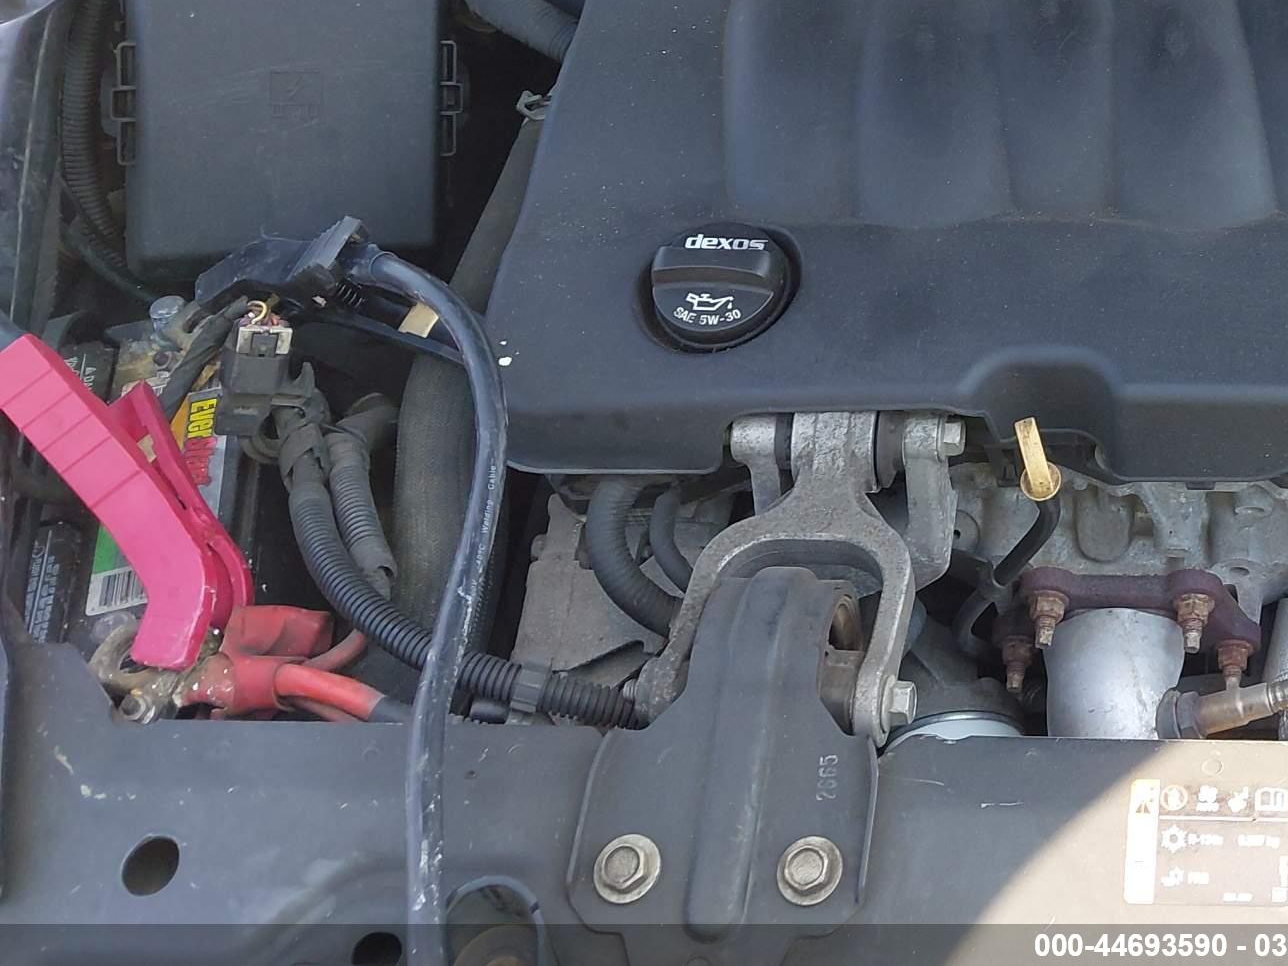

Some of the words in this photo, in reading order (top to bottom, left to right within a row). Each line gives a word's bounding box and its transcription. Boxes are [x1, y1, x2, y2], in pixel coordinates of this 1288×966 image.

[685, 234, 769, 250] dexos
[673, 306, 696, 324] SAE
[699, 309, 742, 325] 5W-30
[487, 465, 497, 491] Cable
[481, 499, 494, 534] Welding
